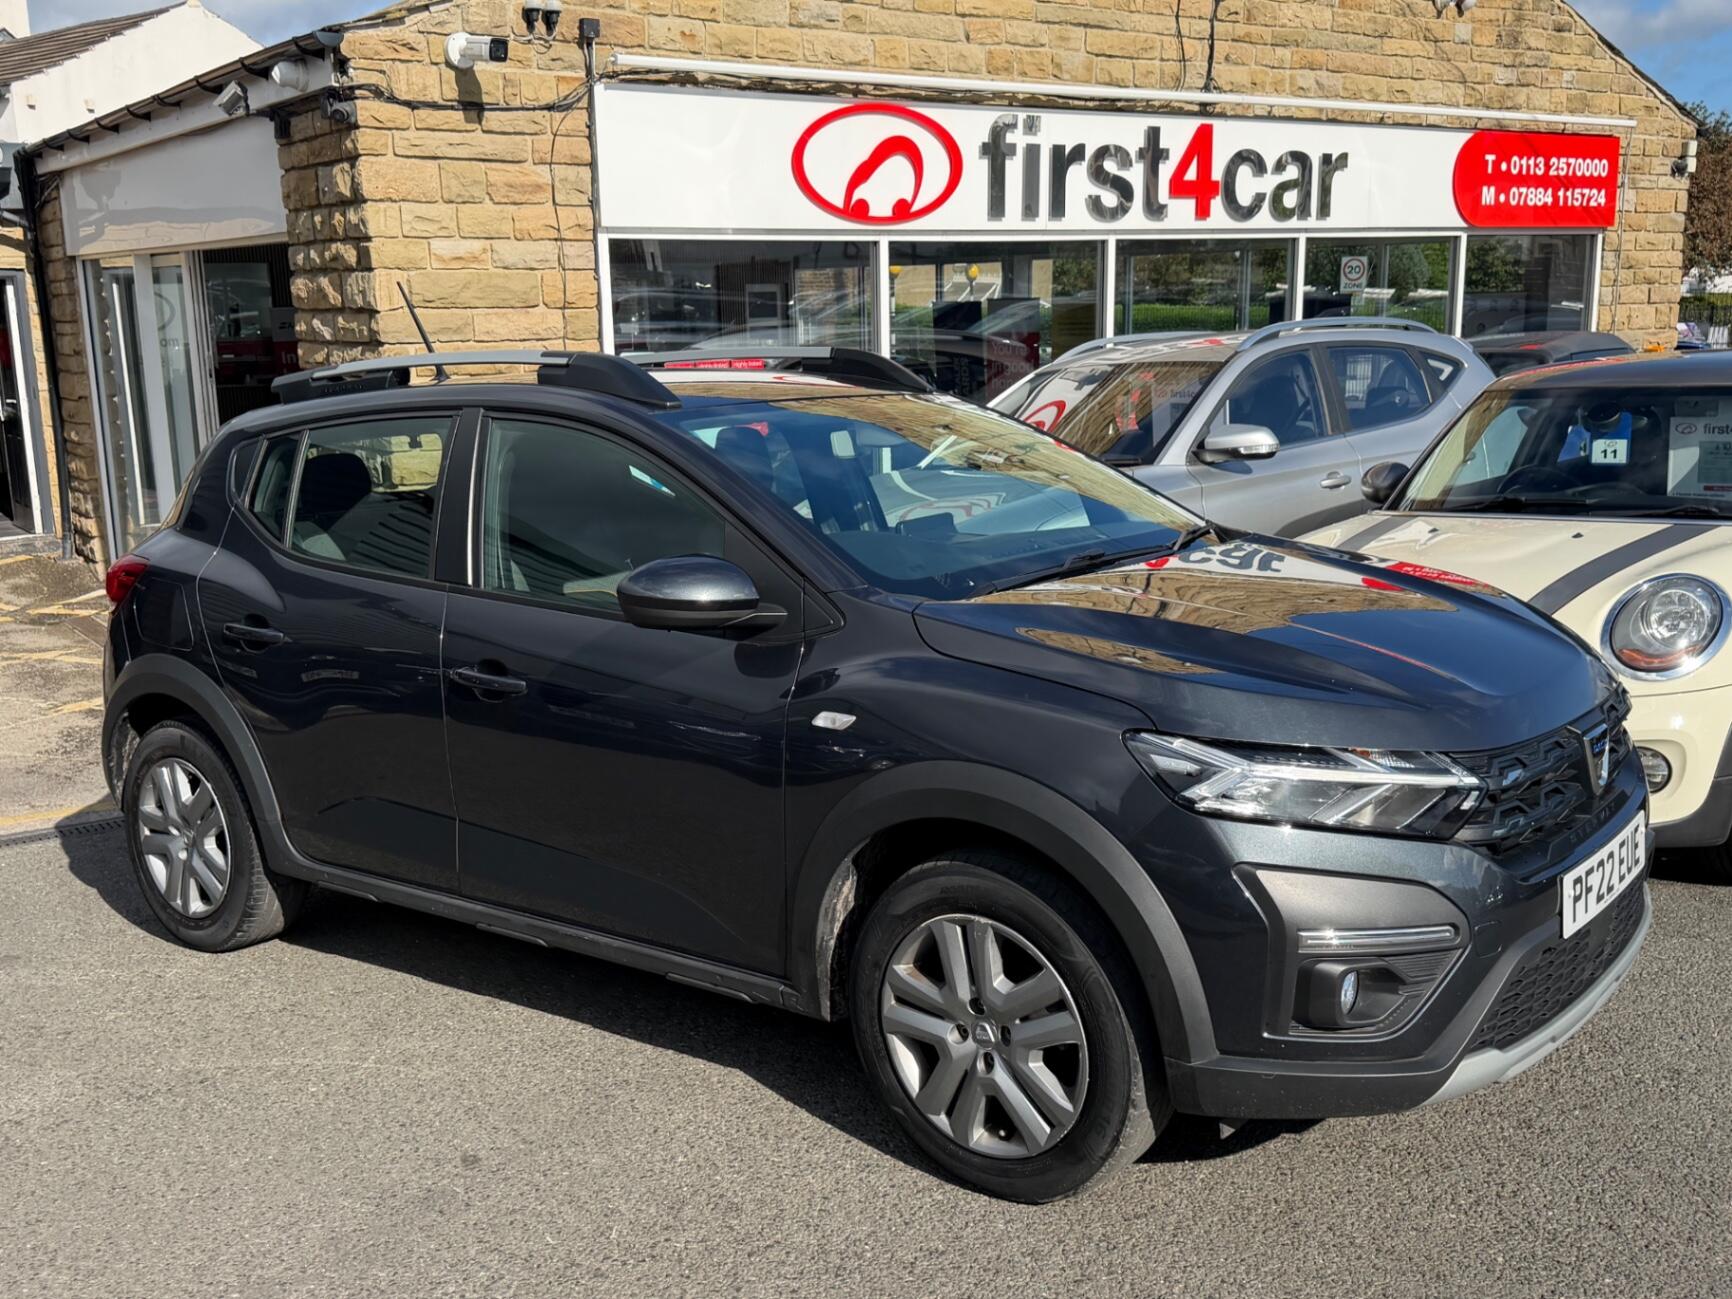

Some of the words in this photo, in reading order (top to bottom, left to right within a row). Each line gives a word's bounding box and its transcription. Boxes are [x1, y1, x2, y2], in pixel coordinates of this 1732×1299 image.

[978, 113, 1349, 223] first4car
[1484, 154, 1497, 174] T
[1510, 155, 1545, 176] 0113
[1549, 157, 1609, 178] 2570000
[1481, 185, 1496, 206] M
[1509, 187, 1553, 206] 07884
[1557, 188, 1606, 207] 115724
[1346, 265, 1362, 275] 20
[1600, 449, 1618, 459] 11
[1572, 850, 1615, 923] PF22
[1618, 823, 1640, 885] EUE
